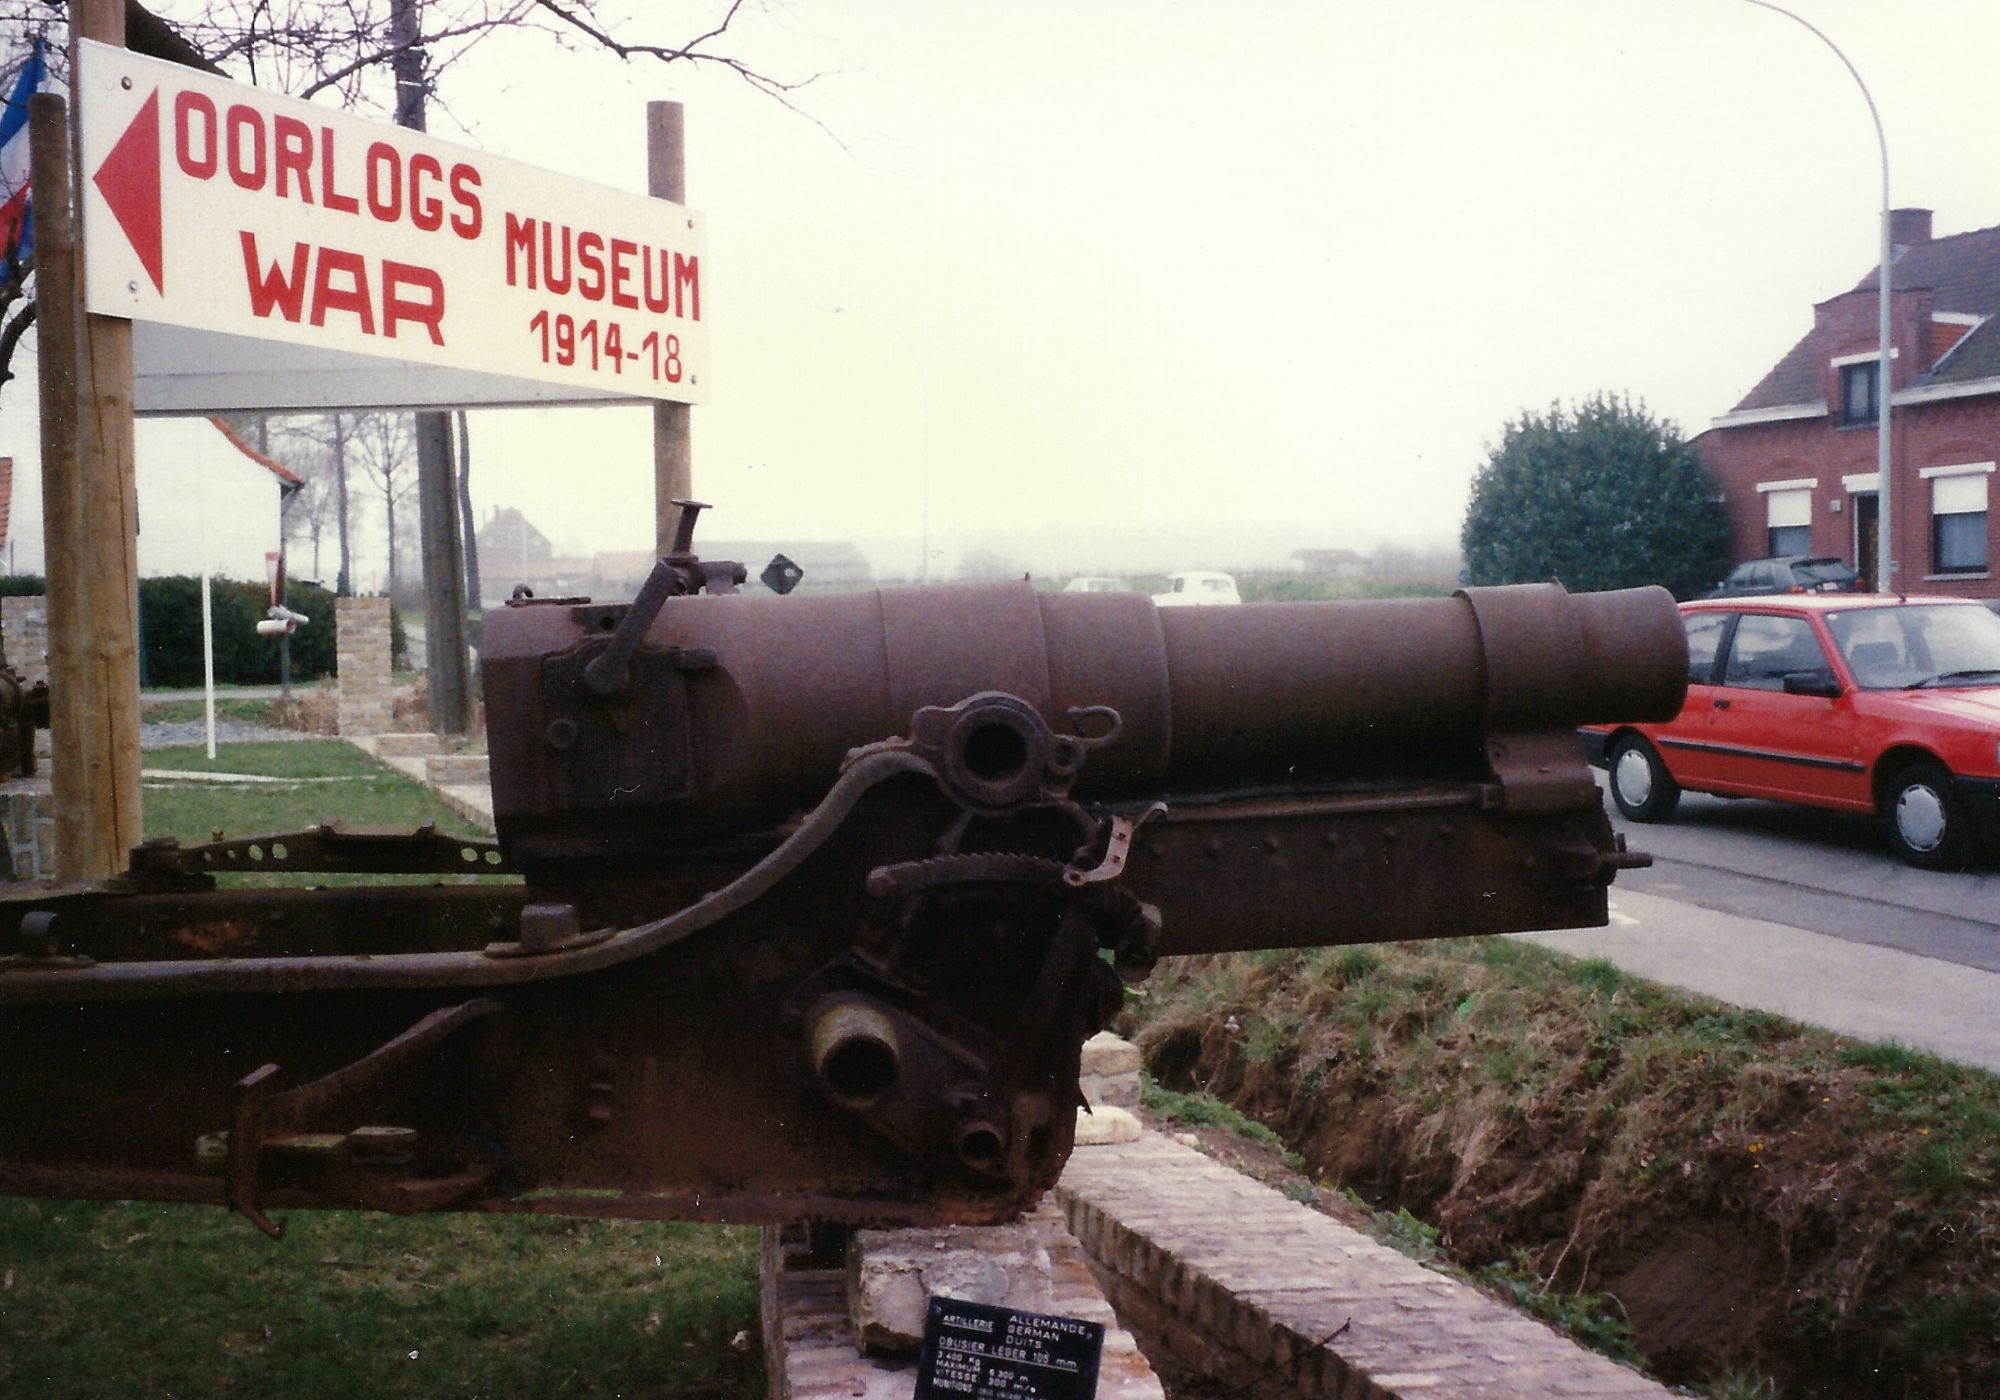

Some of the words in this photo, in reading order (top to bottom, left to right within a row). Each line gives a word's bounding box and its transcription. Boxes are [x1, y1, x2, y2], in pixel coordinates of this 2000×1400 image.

[174, 90, 483, 241] OORLOGS
[504, 212, 701, 322] MUSEUM
[238, 230, 446, 347] WAR
[529, 309, 684, 384] 1914-18
[942, 1314, 994, 1330] ARTILLERIE
[1009, 1315, 1087, 1335] ALLEMANDE
[1007, 1324, 1060, 1342] GERMAN
[938, 1336, 986, 1352] OBUSIER
[991, 1345, 1027, 1360] LEGER
[1033, 1352, 1050, 1364] 105
[1056, 1358, 1077, 1368] mm
[1005, 1335, 1042, 1349] DUITS
[935, 1367, 978, 1383] VITESSE
[936, 1359, 981, 1373] MAXIMUM
[1020, 1375, 1029, 1383] m
[933, 1377, 973, 1393] MUNITIONS
